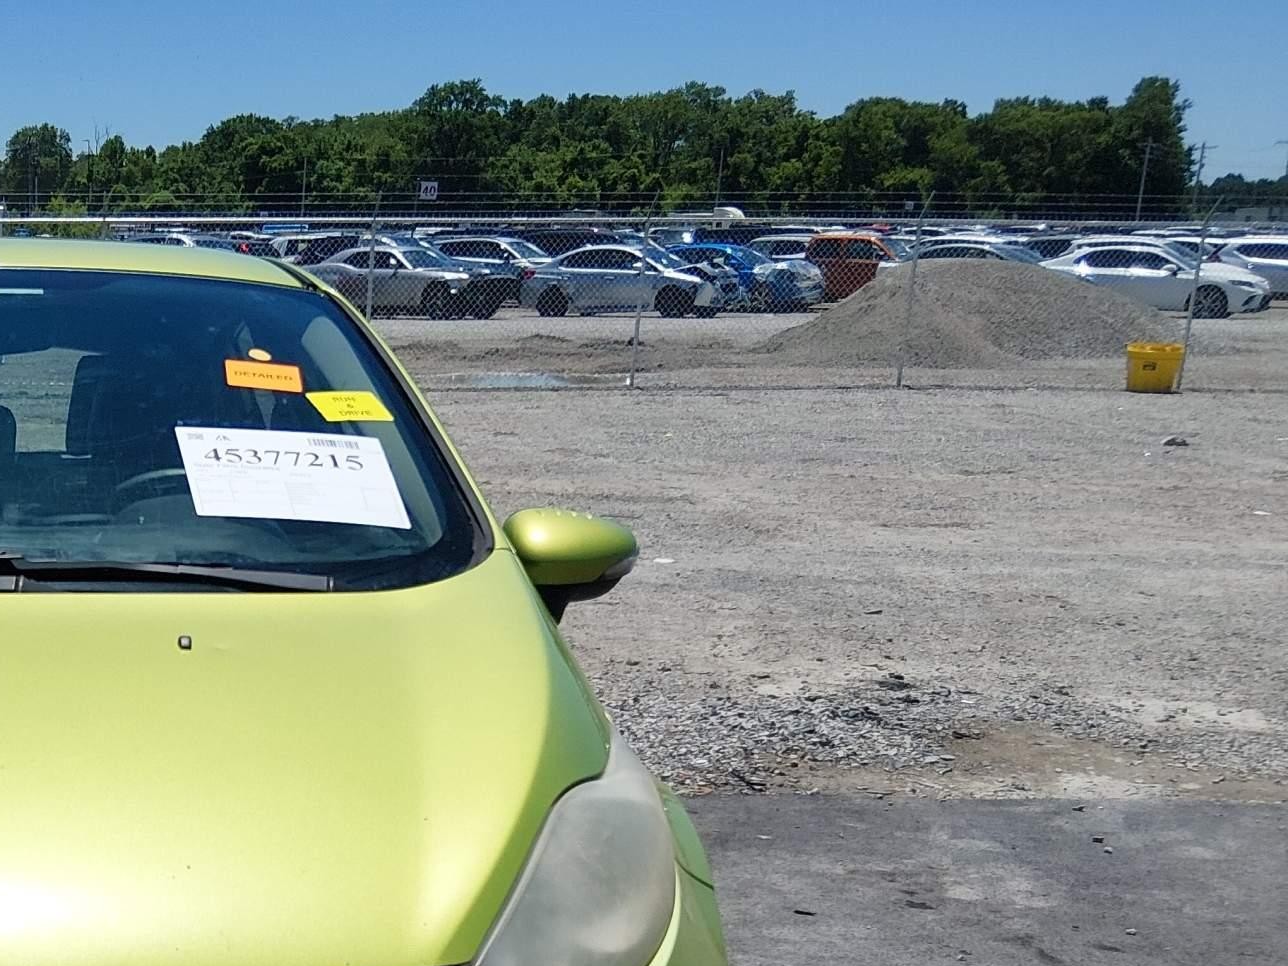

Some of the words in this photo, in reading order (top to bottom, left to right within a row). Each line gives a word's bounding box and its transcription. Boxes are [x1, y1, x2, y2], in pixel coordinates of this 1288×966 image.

[422, 185, 436, 197] 40
[233, 370, 294, 381] DETAILED
[203, 447, 364, 471] 45377215
